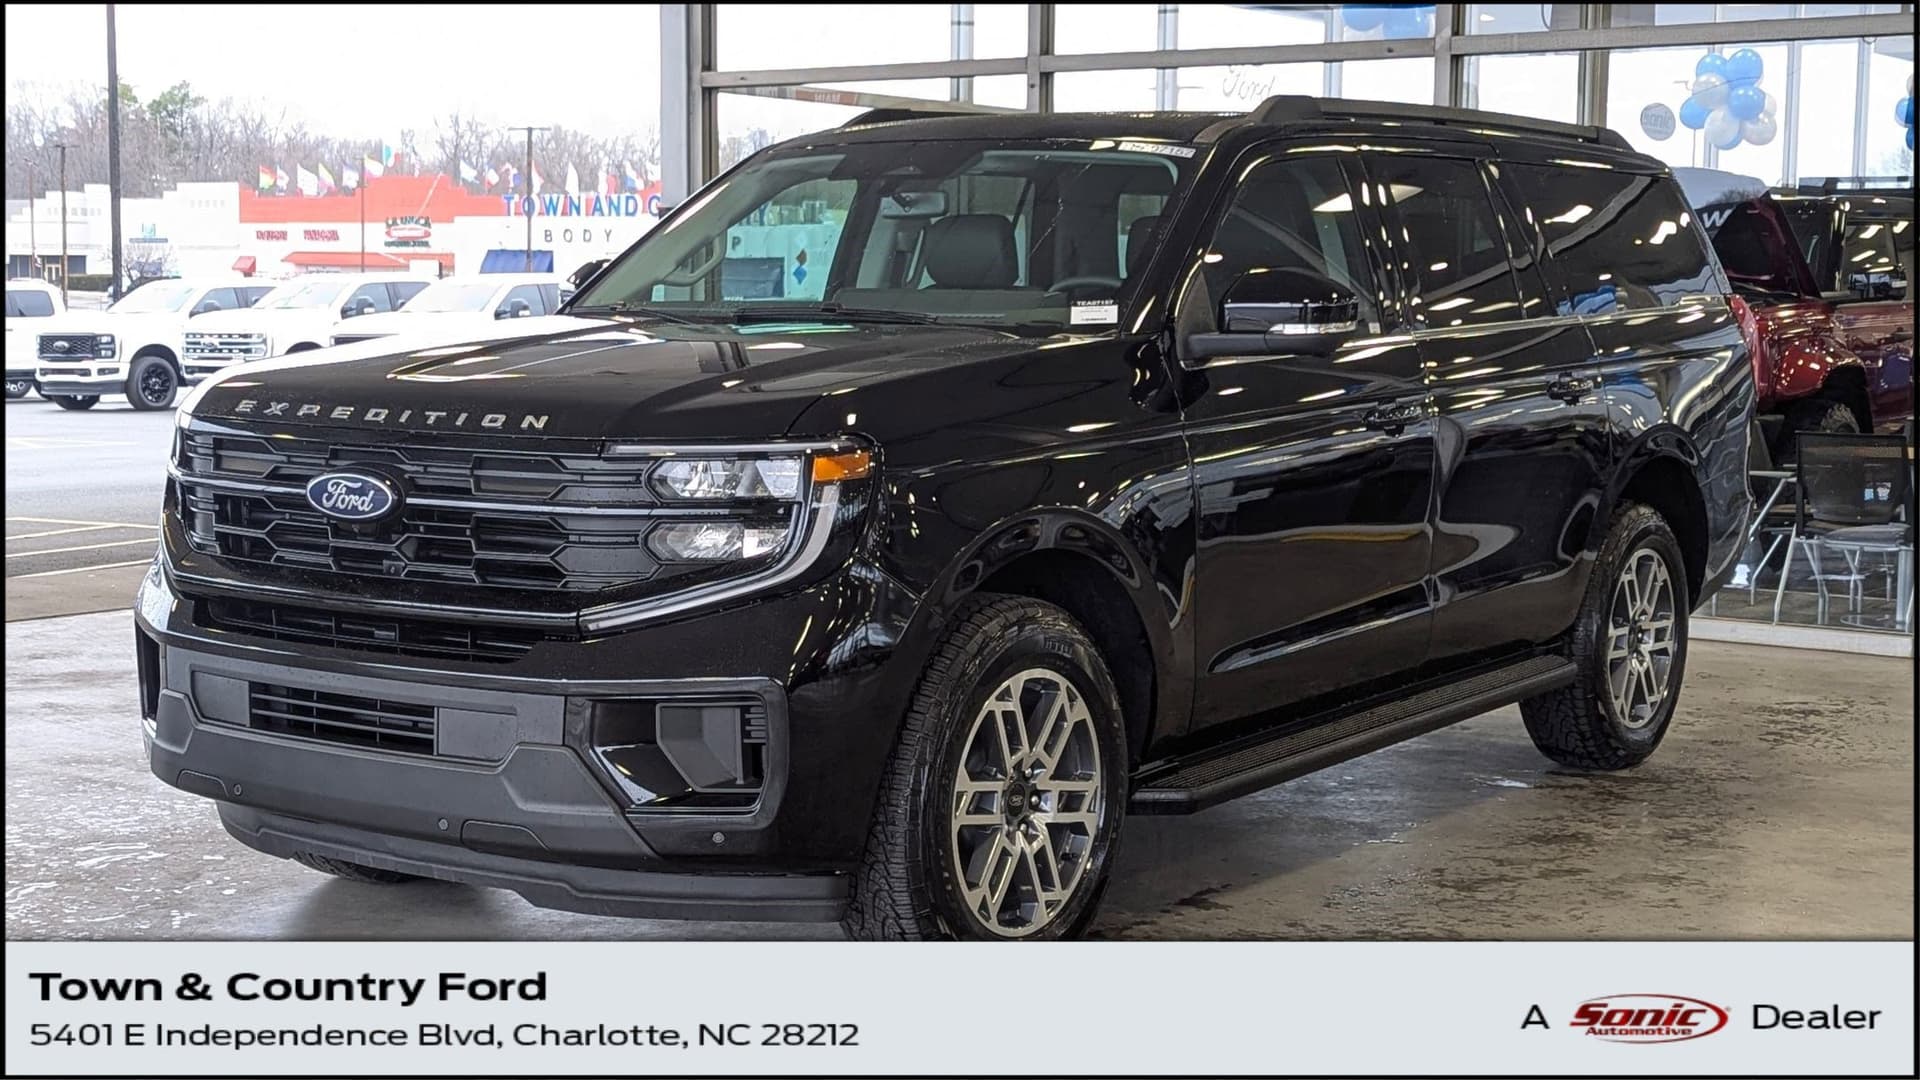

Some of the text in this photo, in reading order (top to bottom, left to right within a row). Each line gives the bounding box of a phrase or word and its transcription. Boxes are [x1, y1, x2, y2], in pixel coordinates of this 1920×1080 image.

[504, 195, 581, 217] TOWN
[592, 195, 638, 217] AND
[544, 229, 612, 243] BODY
[235, 399, 549, 430] EXPEDITION
[322, 478, 374, 513] Ford
